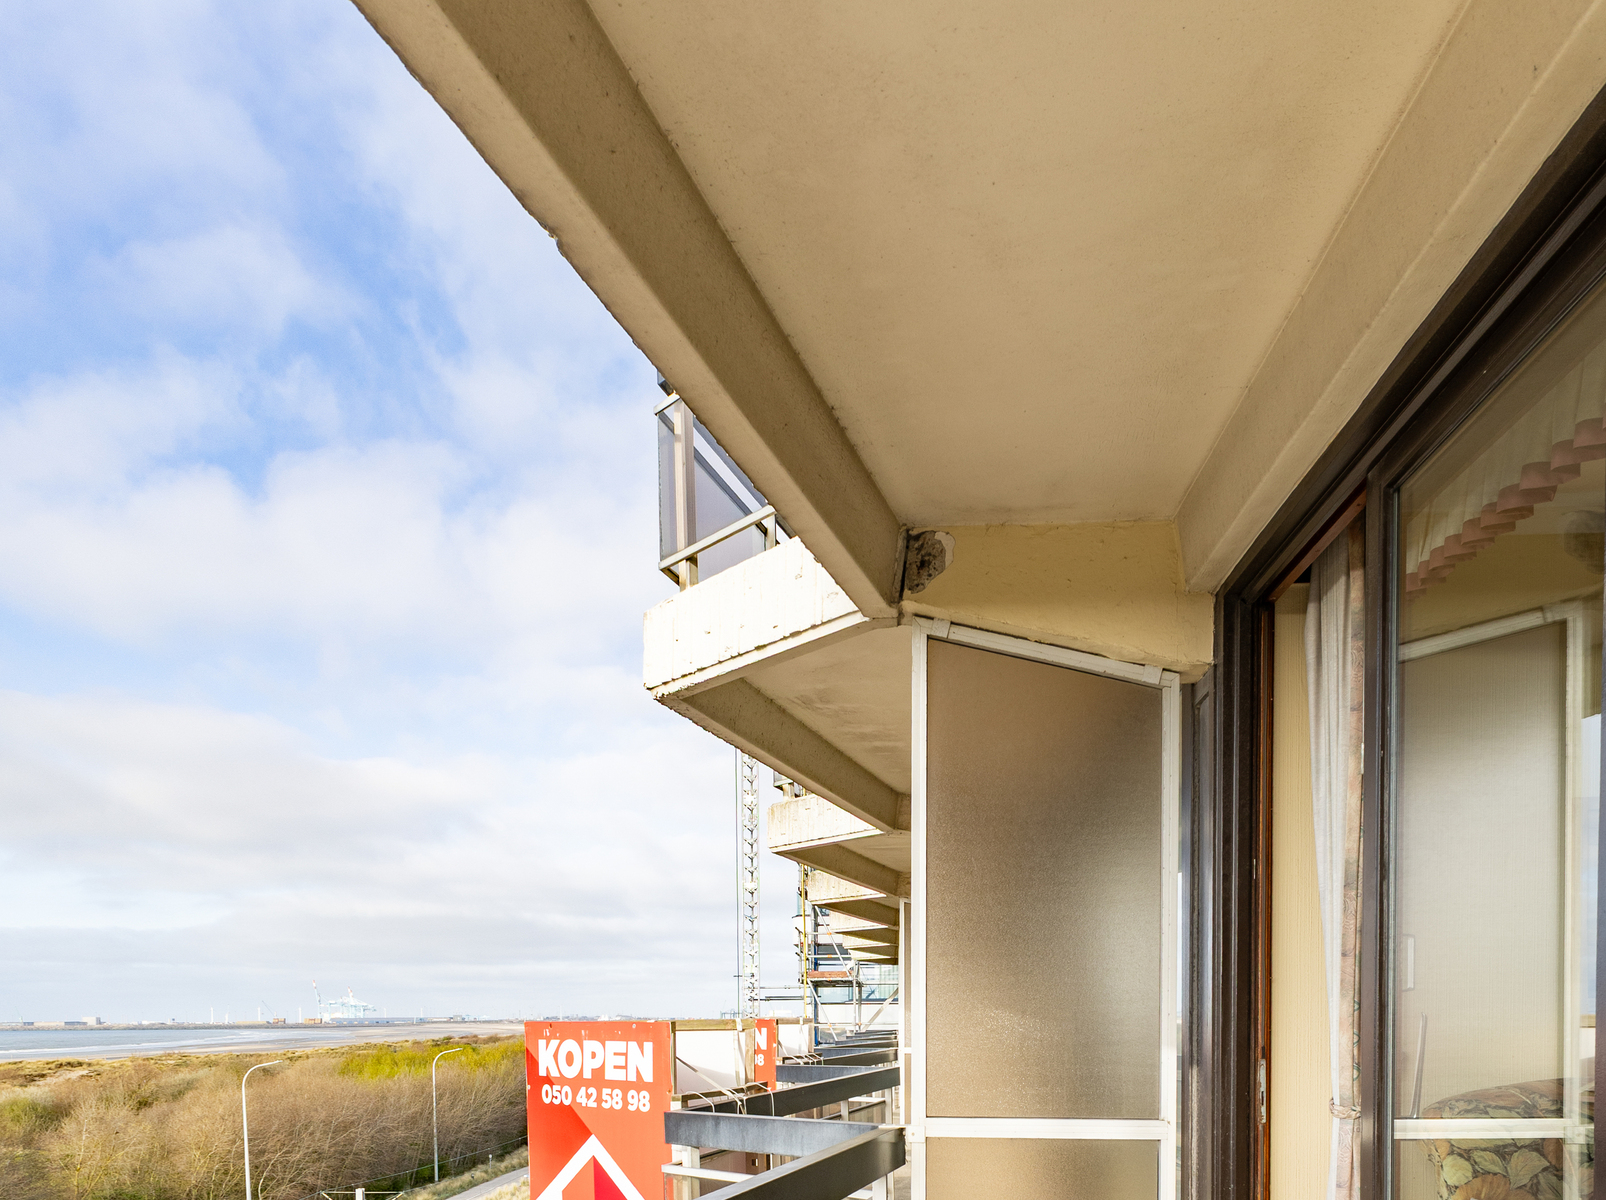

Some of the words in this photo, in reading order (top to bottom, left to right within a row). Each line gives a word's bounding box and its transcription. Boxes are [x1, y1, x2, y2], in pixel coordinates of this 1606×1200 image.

[538, 1039, 653, 1082] KOPEN
[541, 1083, 572, 1106] 050
[576, 1086, 597, 1107] 42
[601, 1088, 623, 1110] 58
[627, 1089, 651, 1112] 98
